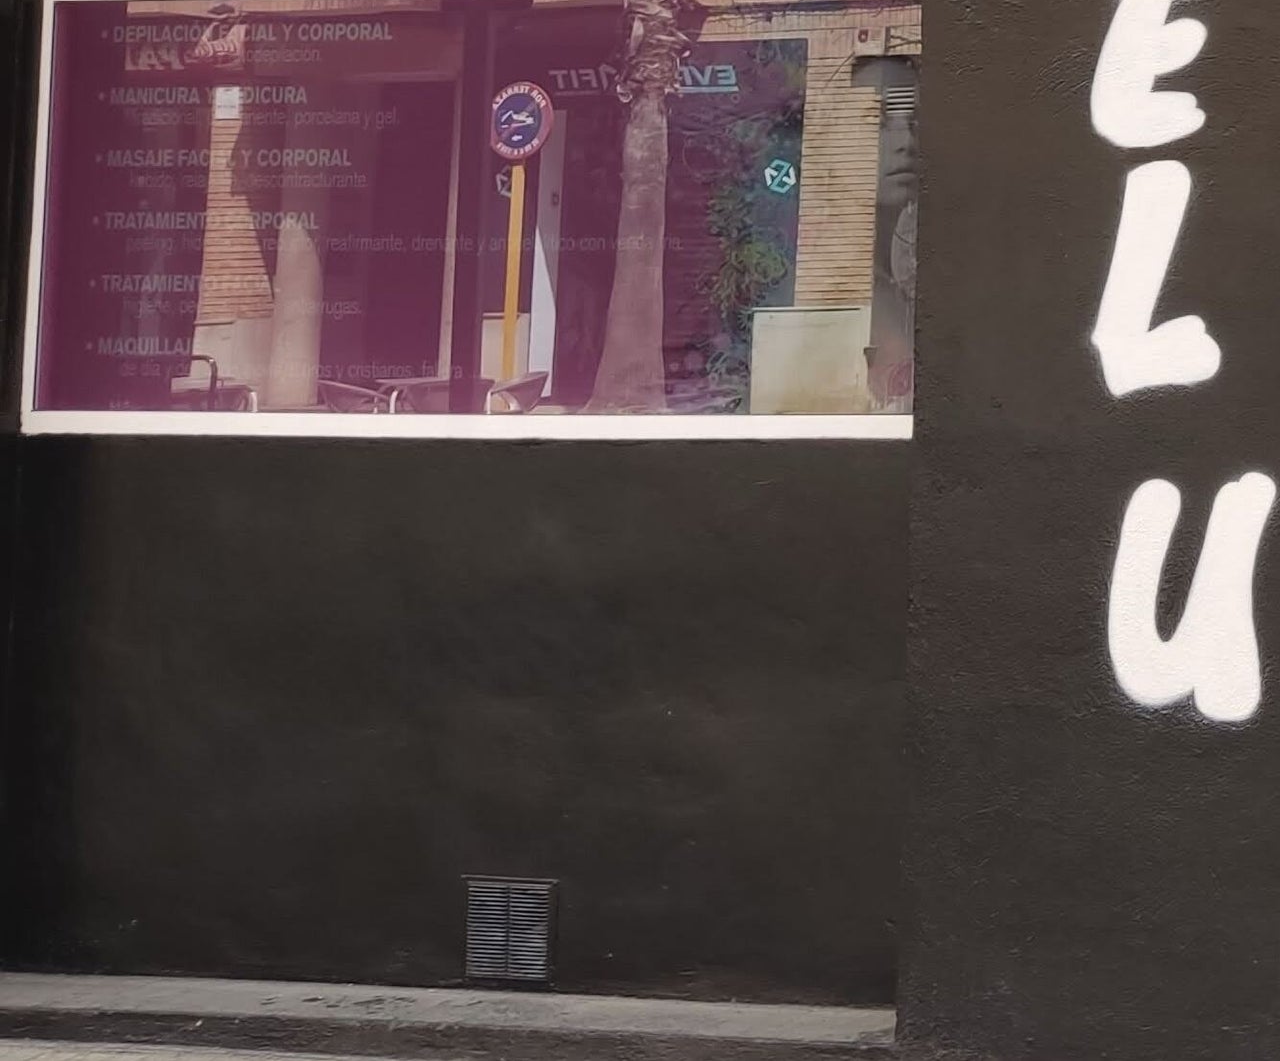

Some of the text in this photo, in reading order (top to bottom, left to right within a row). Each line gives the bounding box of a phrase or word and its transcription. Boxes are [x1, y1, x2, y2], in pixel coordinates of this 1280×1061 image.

[218, 24, 277, 41] FCIAL
[282, 24, 294, 41] Y
[298, 22, 394, 41] CORPORAL
[110, 87, 200, 104] MANICURA
[219, 86, 307, 104] EDICURA
[107, 148, 352, 167] MASAJE FACL Y CORPORAL
[105, 210, 319, 230] TRATAMIENT RPORAL
[97, 337, 200, 356] MAQUILLAJ
